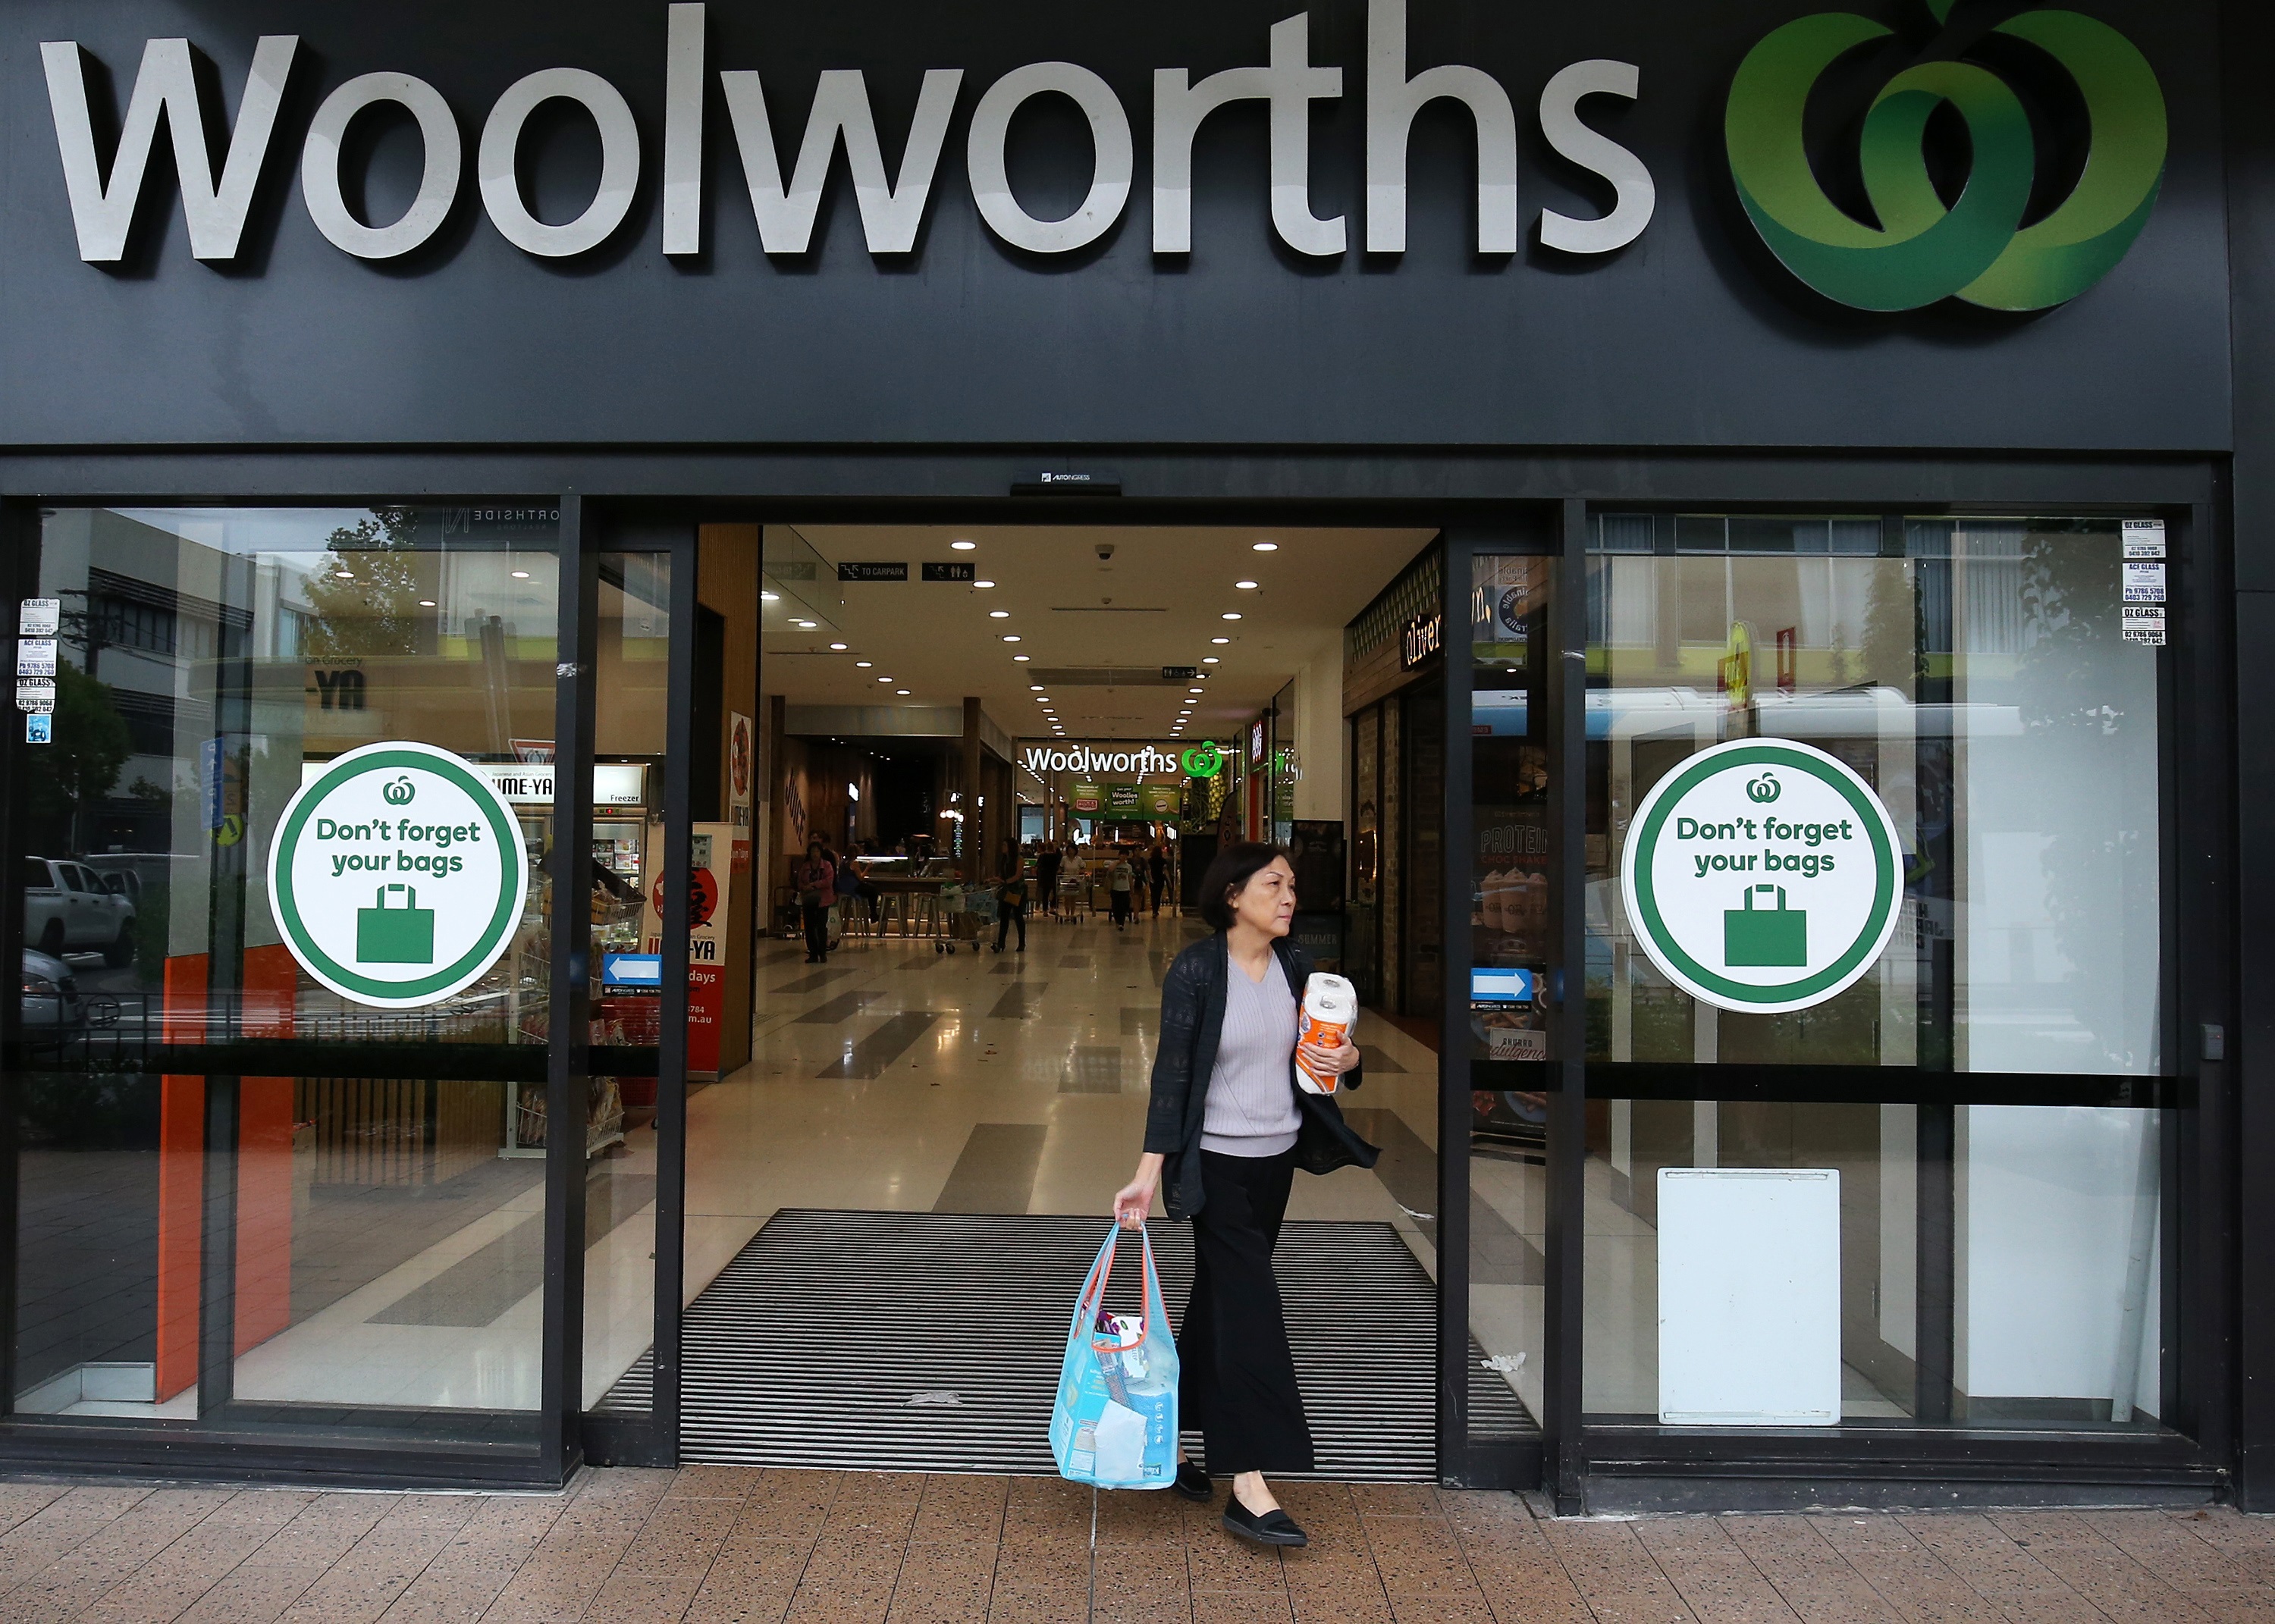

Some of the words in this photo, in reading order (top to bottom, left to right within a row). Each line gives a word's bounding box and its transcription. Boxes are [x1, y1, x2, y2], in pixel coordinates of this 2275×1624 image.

[39, 0, 1655, 262] Woolworths
[862, 567, 871, 576] TO
[872, 567, 905, 576] CARPARK
[2125, 608, 2134, 616] OZ
[2135, 608, 2159, 617] GLASS
[1406, 614, 1441, 666] oliver
[322, 656, 362, 667] Grocery
[29, 679, 51, 687] GLASS
[1025, 746, 1177, 773] Woolworths
[610, 794, 639, 802] Freezer
[317, 818, 391, 841] Don’t
[397, 818, 481, 848] forget
[1677, 817, 1758, 840] Don’t
[1763, 817, 1853, 848] forget
[331, 854, 391, 877] your
[397, 849, 463, 879] bags
[1694, 854, 1758, 878] your
[1764, 848, 1835, 878] bags
[689, 970, 716, 985] days
